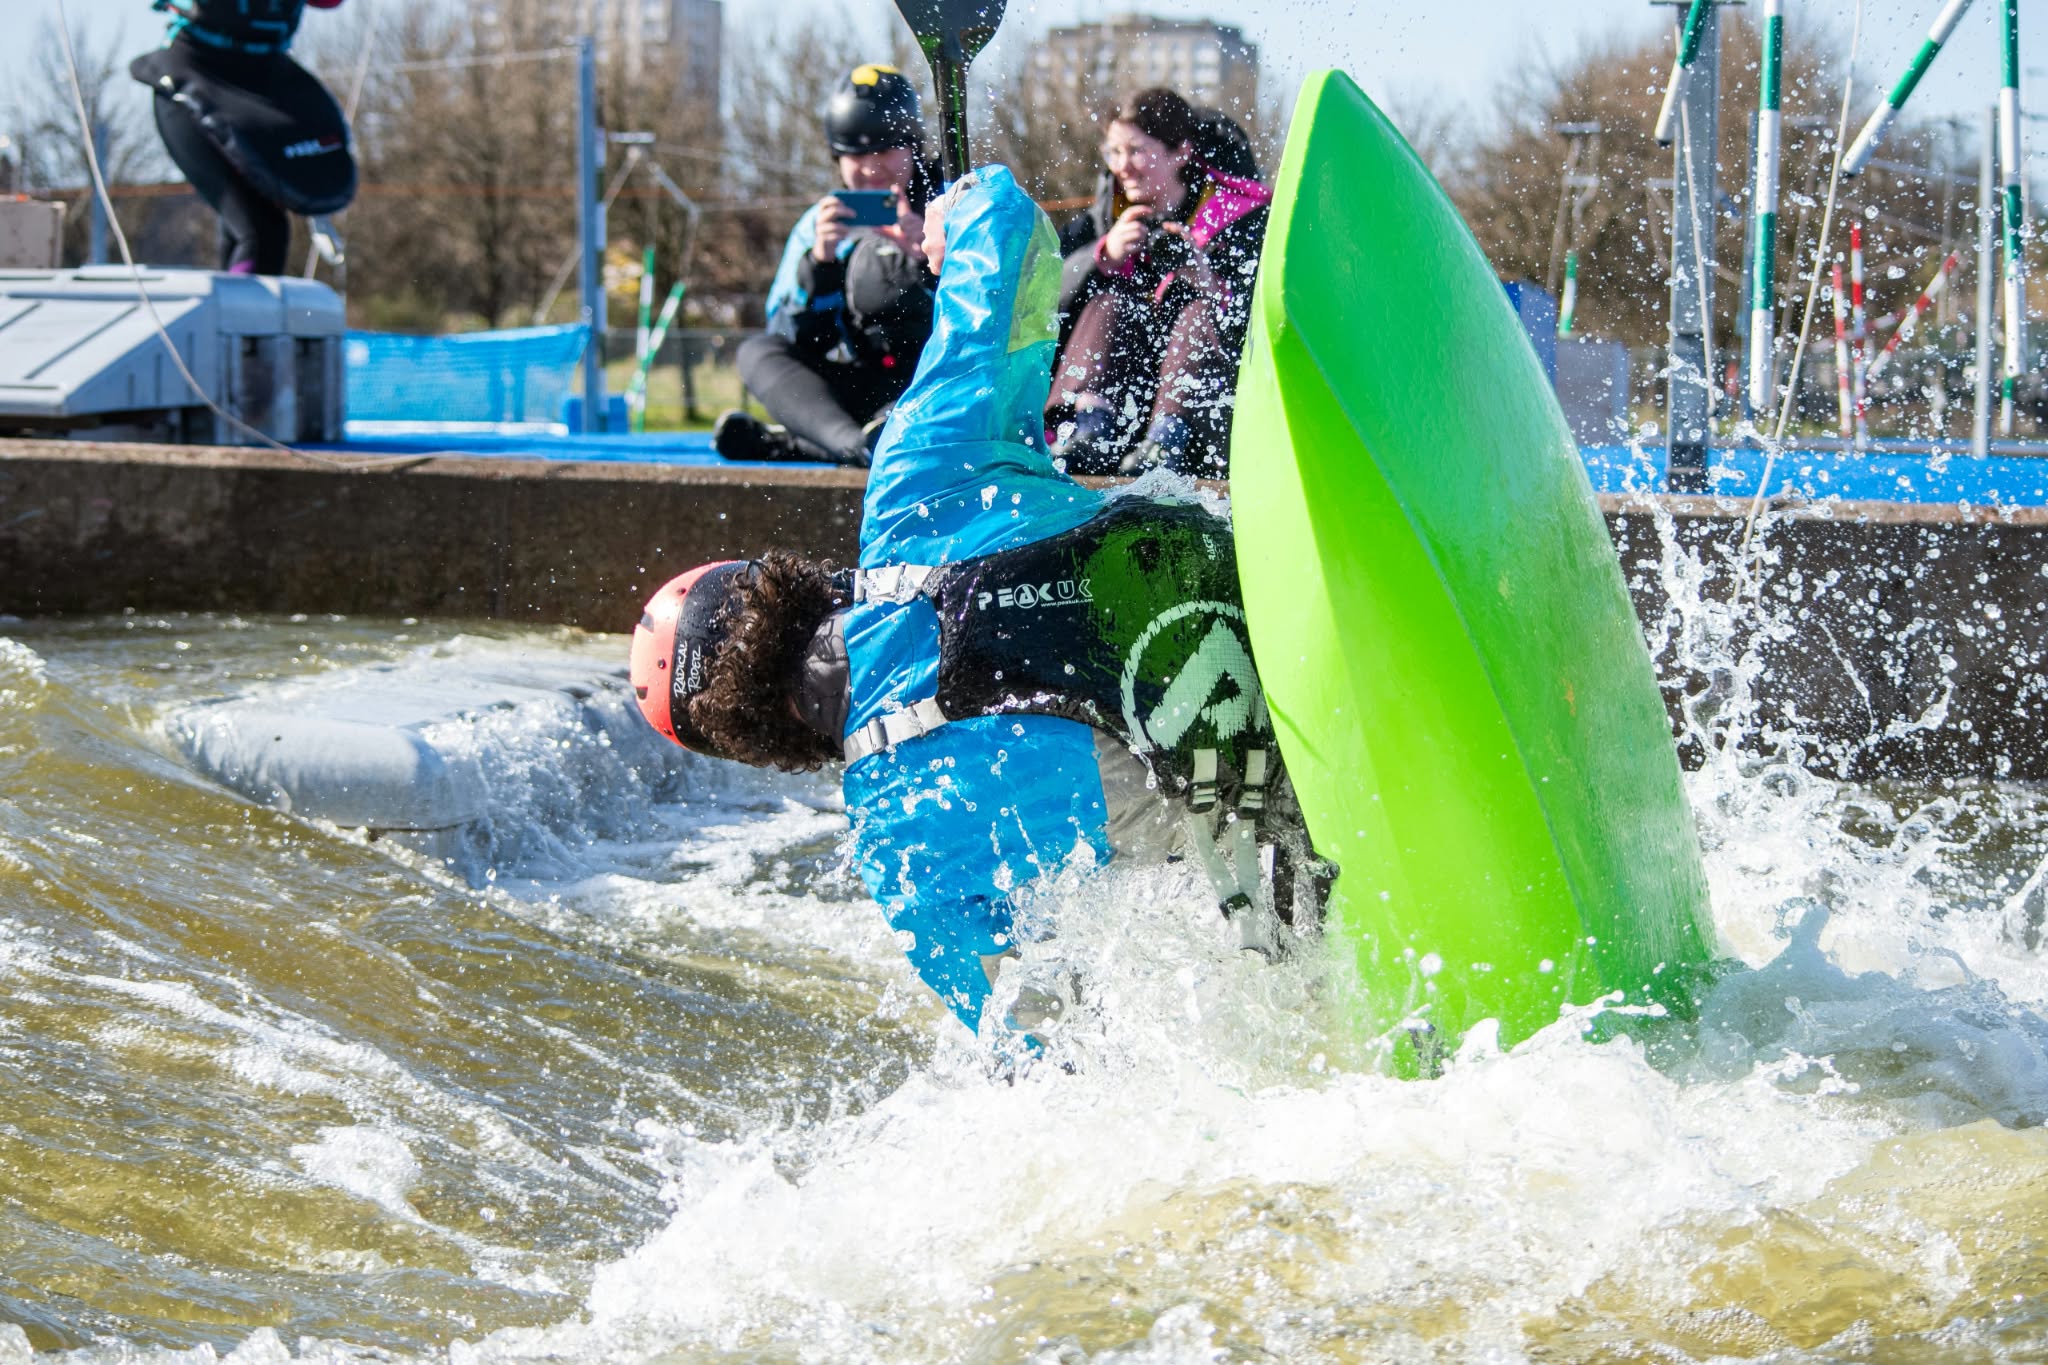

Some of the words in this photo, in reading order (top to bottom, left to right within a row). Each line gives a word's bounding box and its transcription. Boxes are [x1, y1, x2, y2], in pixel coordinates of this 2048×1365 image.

[978, 583, 1054, 610] PEAK
[1057, 579, 1093, 599] UK
[673, 640, 688, 698] RADICAL
[687, 645, 702, 693] RIDER
